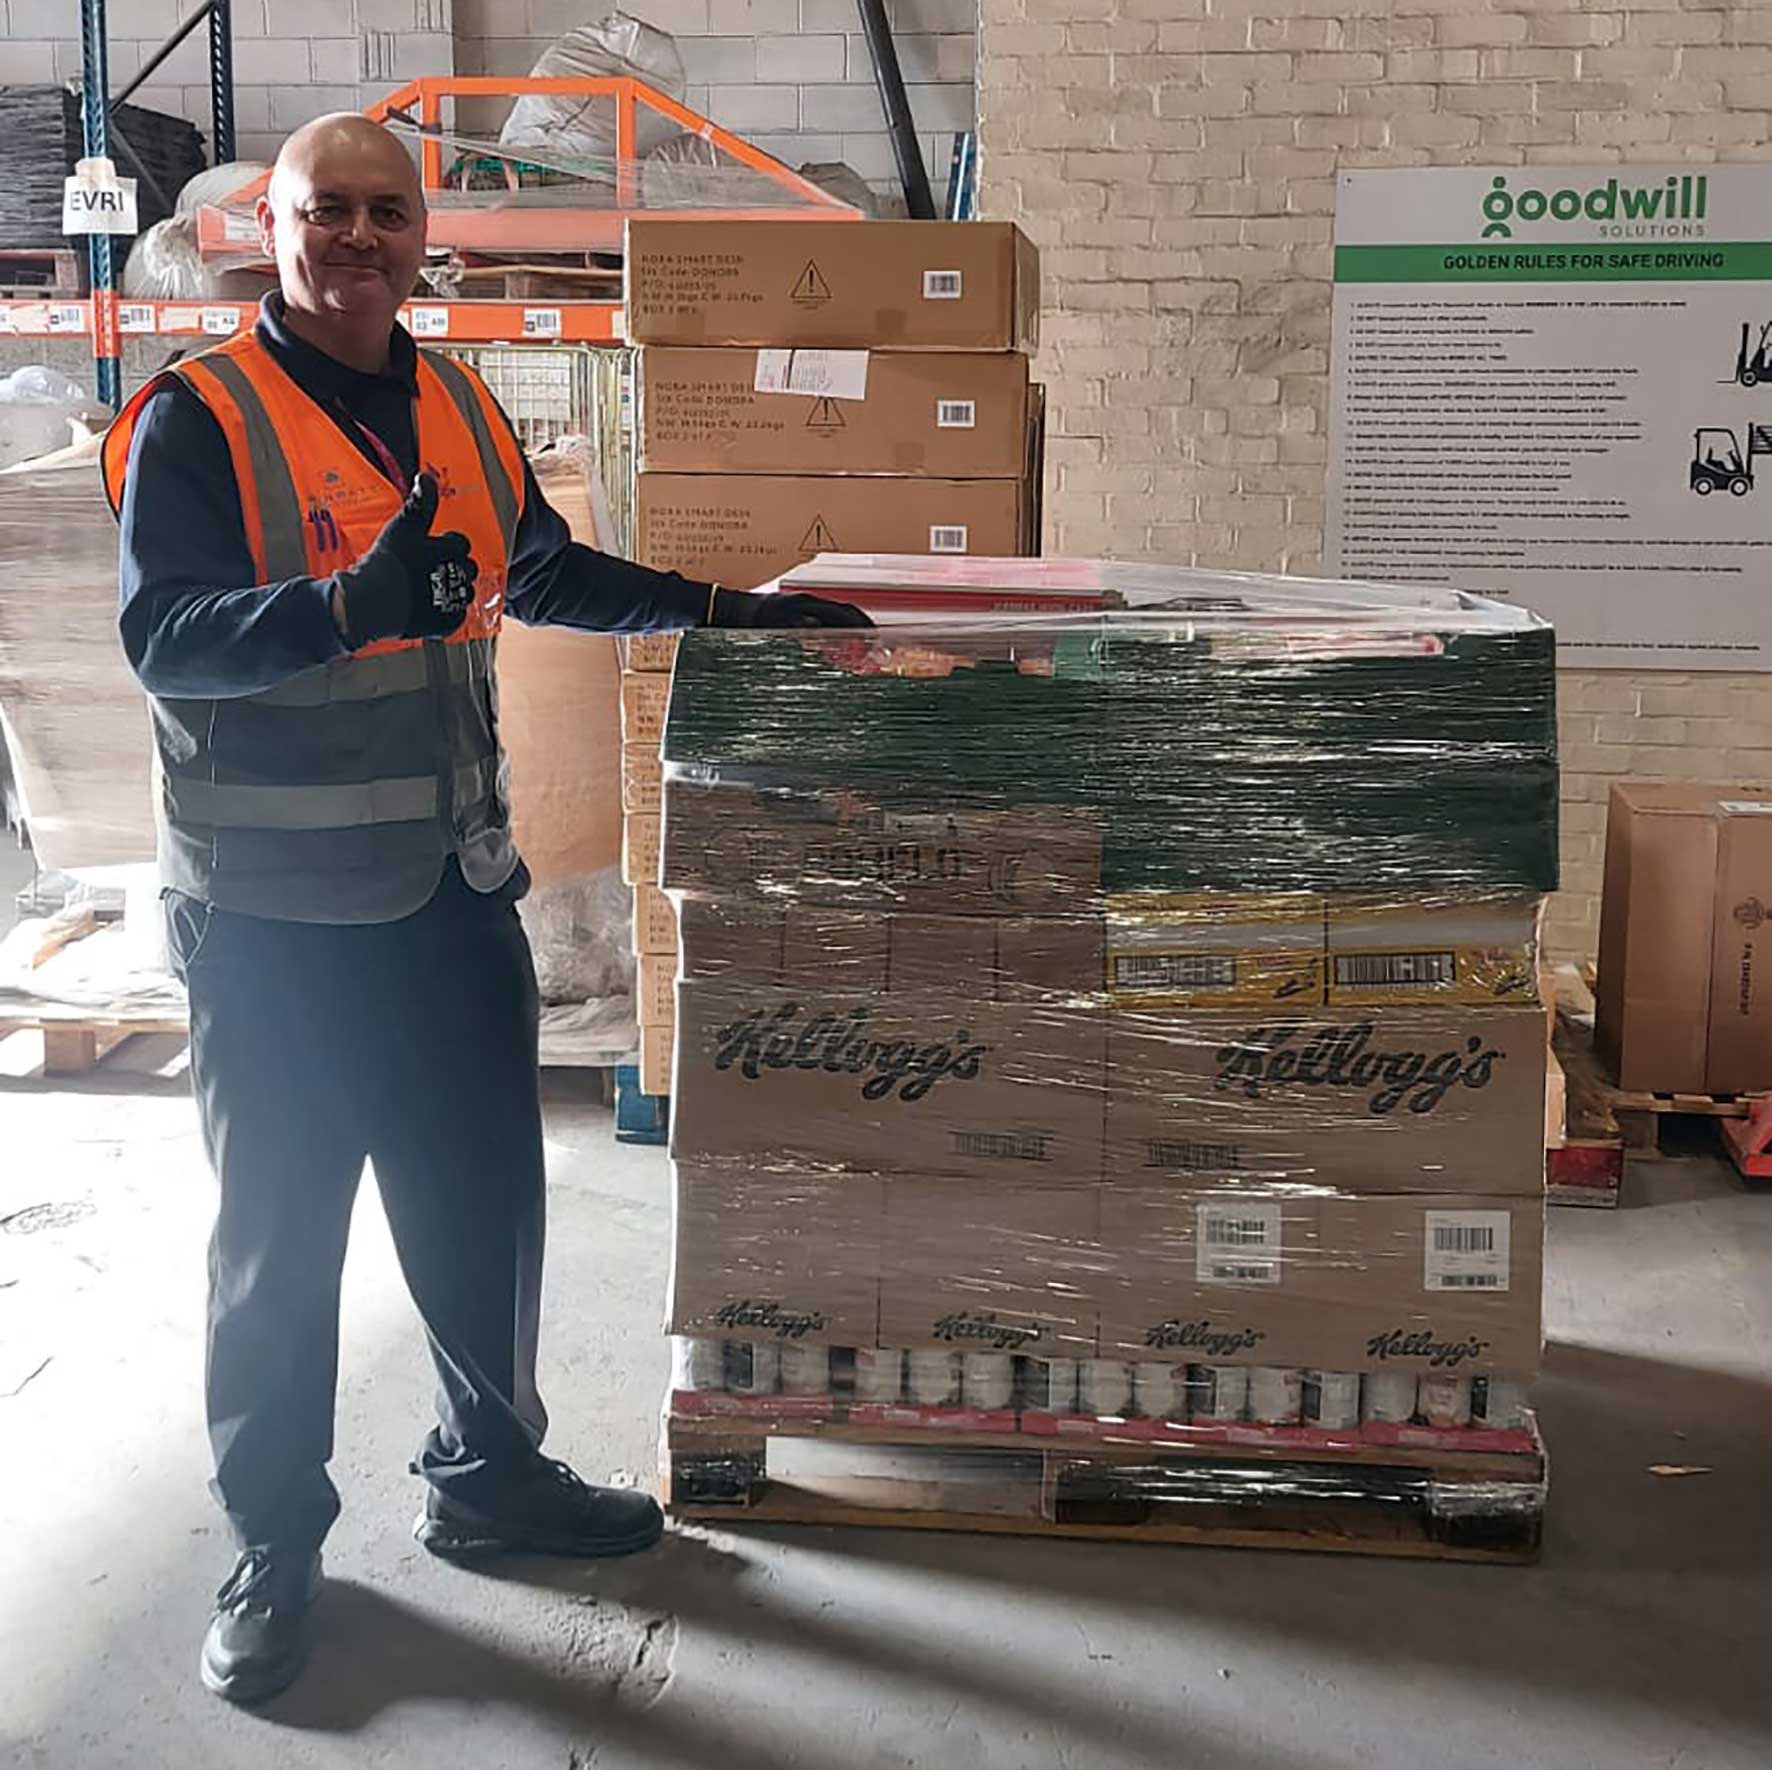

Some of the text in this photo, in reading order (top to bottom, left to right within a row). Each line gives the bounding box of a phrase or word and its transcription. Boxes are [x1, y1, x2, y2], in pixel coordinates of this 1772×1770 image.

[70, 190, 124, 212] EVRI
[1481, 176, 1707, 238] goodwill
[1600, 225, 1706, 238] SOLUTIONS
[1443, 252, 1725, 270] GOLDEN RULES FOR SAFE DRIVING
[714, 1001, 988, 1102] Kellogg's
[1213, 1018, 1507, 1114] Kellogg's
[715, 1299, 830, 1340] Kellogg's
[931, 1310, 1050, 1348] Kellogg's
[1144, 1318, 1266, 1357] Kellogg's
[1366, 1328, 1490, 1368] Kellogg's
